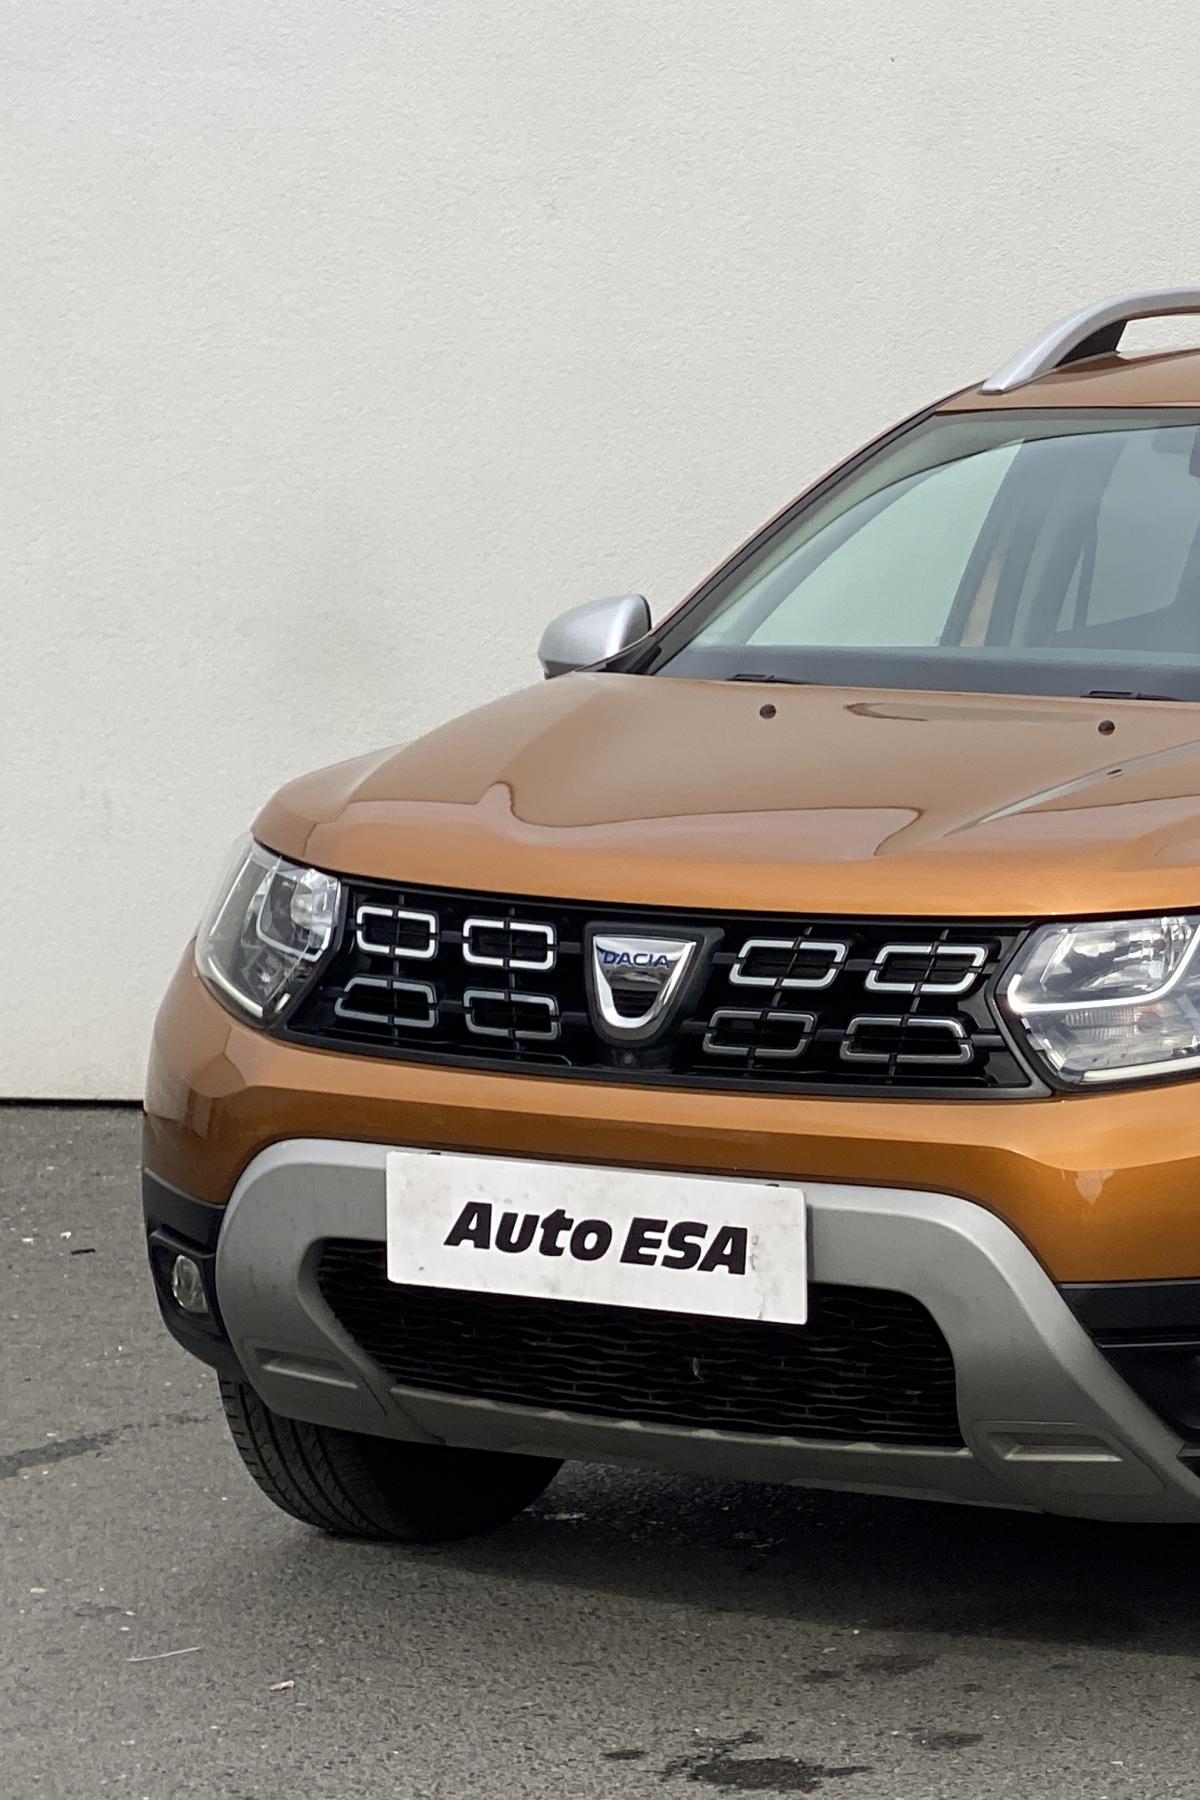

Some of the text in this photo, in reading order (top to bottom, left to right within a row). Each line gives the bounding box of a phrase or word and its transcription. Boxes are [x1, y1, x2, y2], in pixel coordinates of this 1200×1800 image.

[602, 951, 671, 969] DACIA
[443, 1201, 748, 1275] Auto ESA
